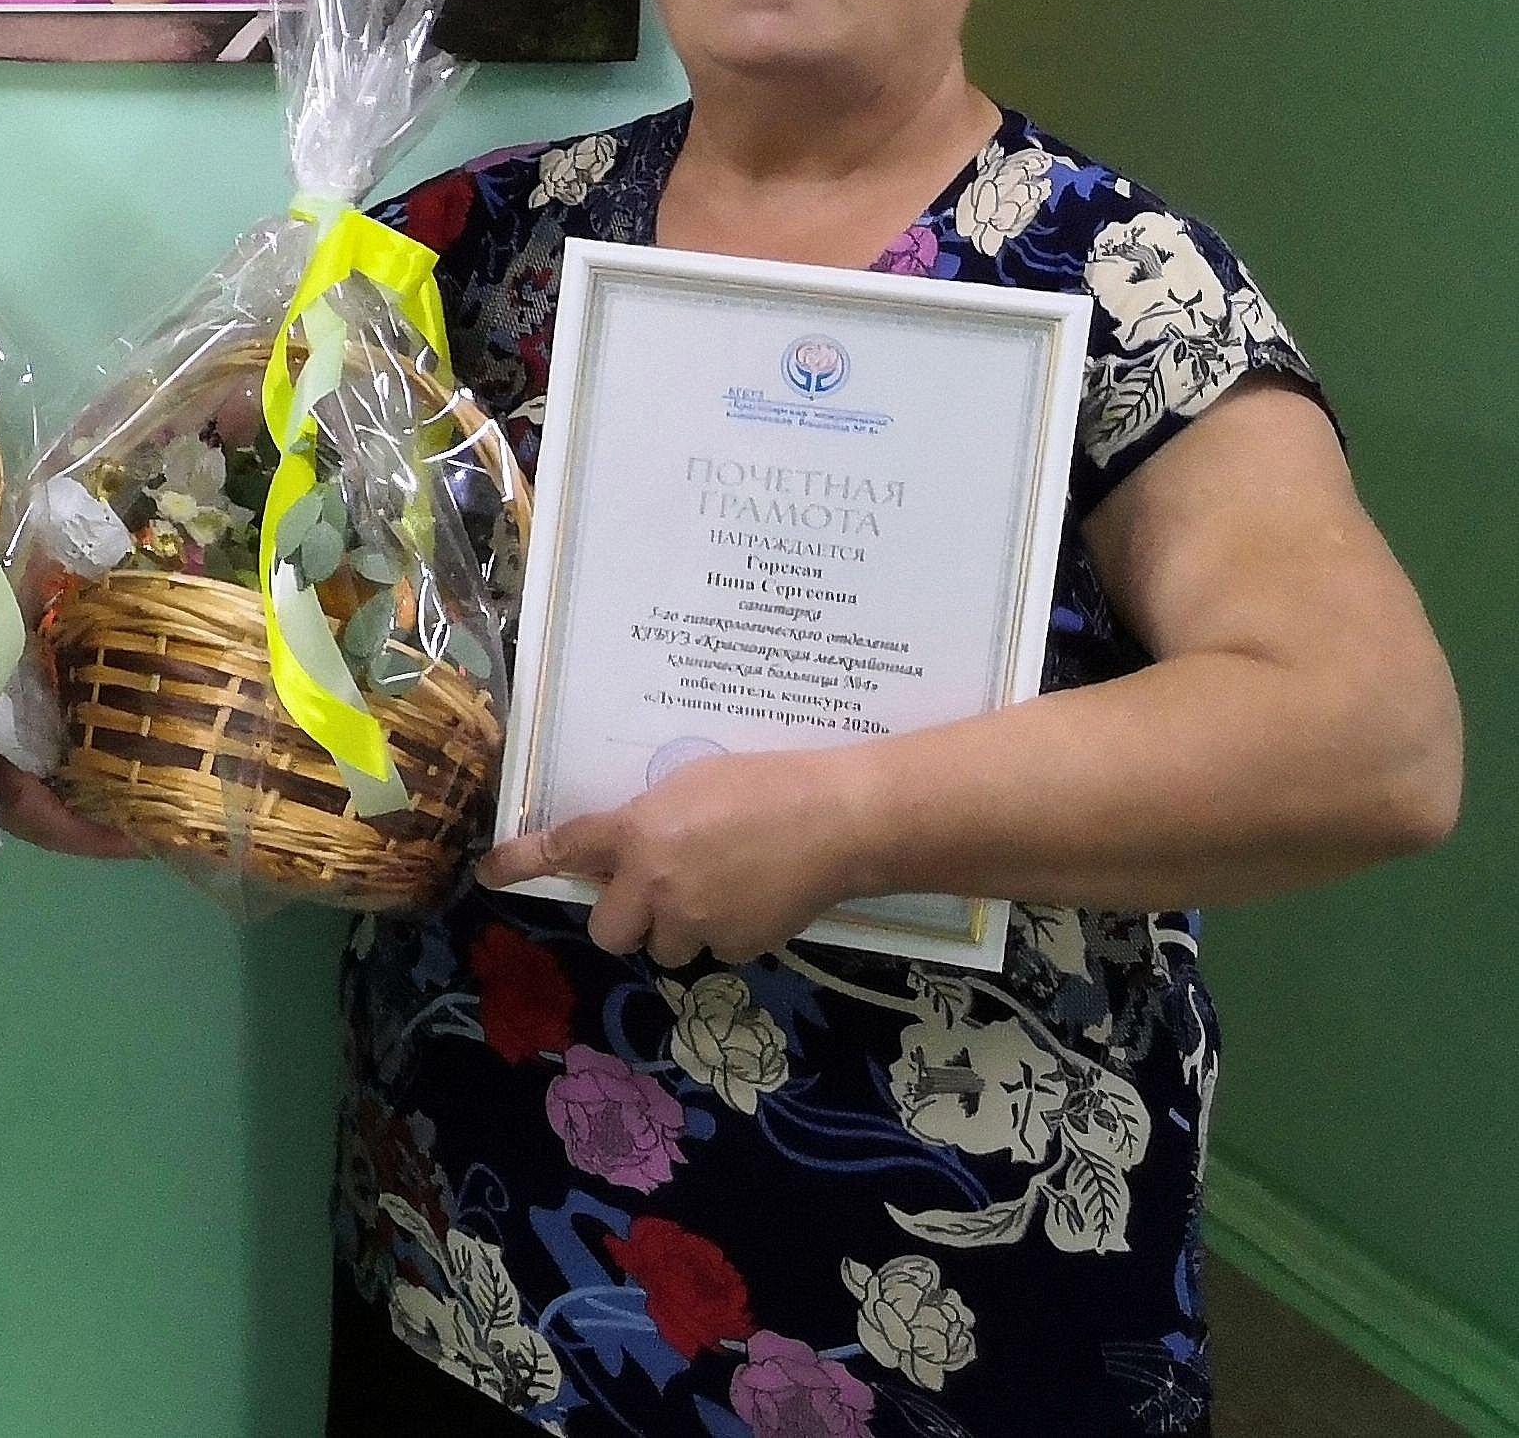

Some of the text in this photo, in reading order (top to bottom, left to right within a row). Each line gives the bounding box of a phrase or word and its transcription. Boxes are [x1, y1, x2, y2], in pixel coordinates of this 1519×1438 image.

[685, 457, 905, 508] ПОЧЕТНАЯ
[697, 492, 881, 537] ГРАМОТА
[709, 528, 865, 562] НАГРАЖДАЕТСЯ
[706, 571, 755, 592] Нина
[746, 553, 823, 579] Горская
